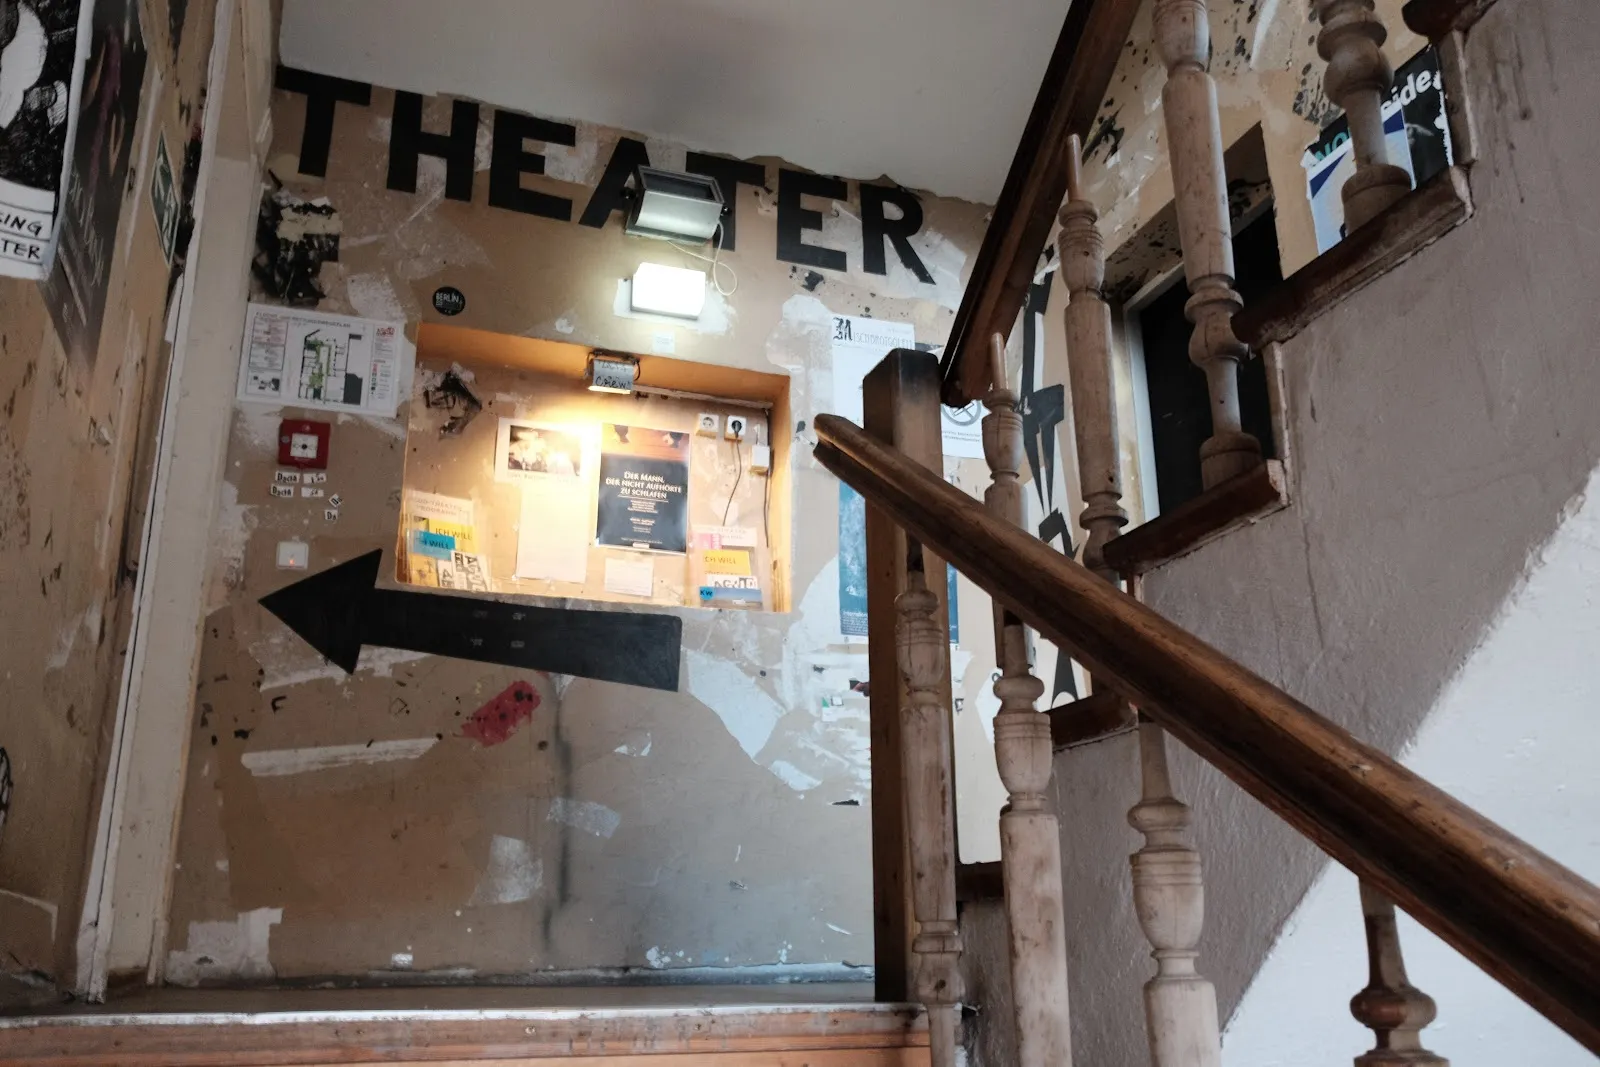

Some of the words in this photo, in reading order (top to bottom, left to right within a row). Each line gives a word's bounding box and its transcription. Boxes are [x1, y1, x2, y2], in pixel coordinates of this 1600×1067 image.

[274, 65, 936, 285] THEATER
[0, 213, 42, 237] ING
[621, 480, 645, 489] NICHT
[631, 489, 667, 499] SCHLAFEN
[451, 531, 473, 541] WILL
[429, 540, 449, 549] WILL
